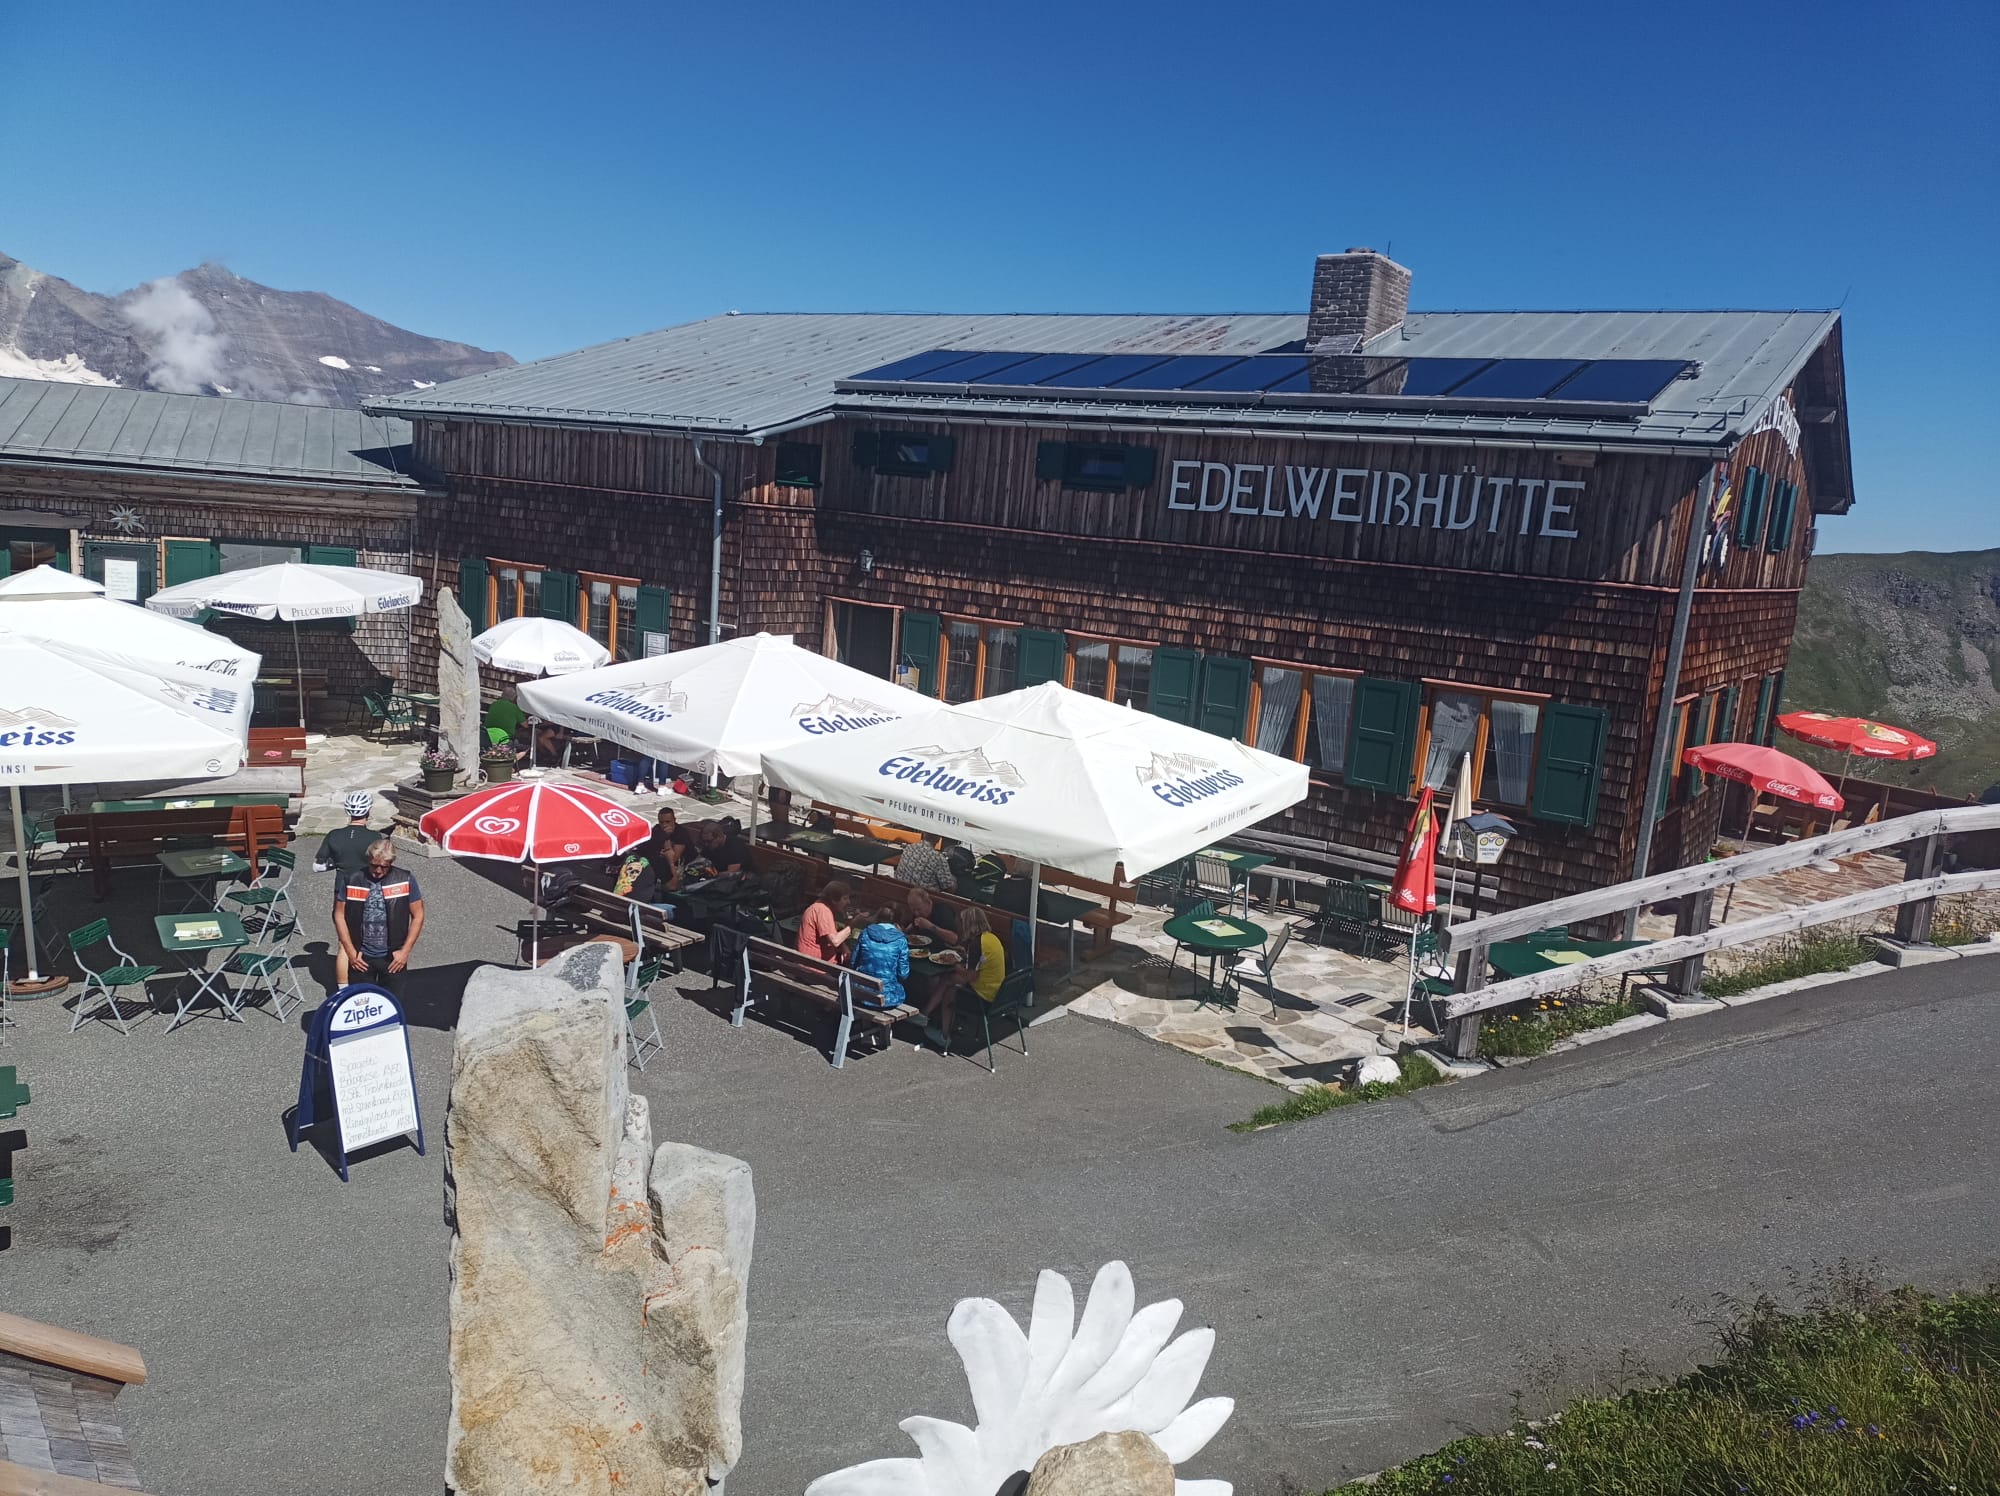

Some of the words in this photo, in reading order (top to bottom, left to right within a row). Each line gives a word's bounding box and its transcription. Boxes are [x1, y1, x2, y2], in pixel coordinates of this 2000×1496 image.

[322, 606, 334, 615] DIR
[335, 604, 354, 614] EINS!
[377, 594, 410, 610] Edelweiss
[585, 690, 672, 723] Edelweiss
[799, 713, 902, 735] Edelwei
[878, 756, 1015, 805] Edelweiss
[1152, 769, 1245, 807] Edelweiss
[889, 799, 918, 815] PFLÜCK
[921, 808, 934, 820] DIR
[938, 812, 961, 827] EINS!
[343, 1005, 383, 1025] Zipfer
